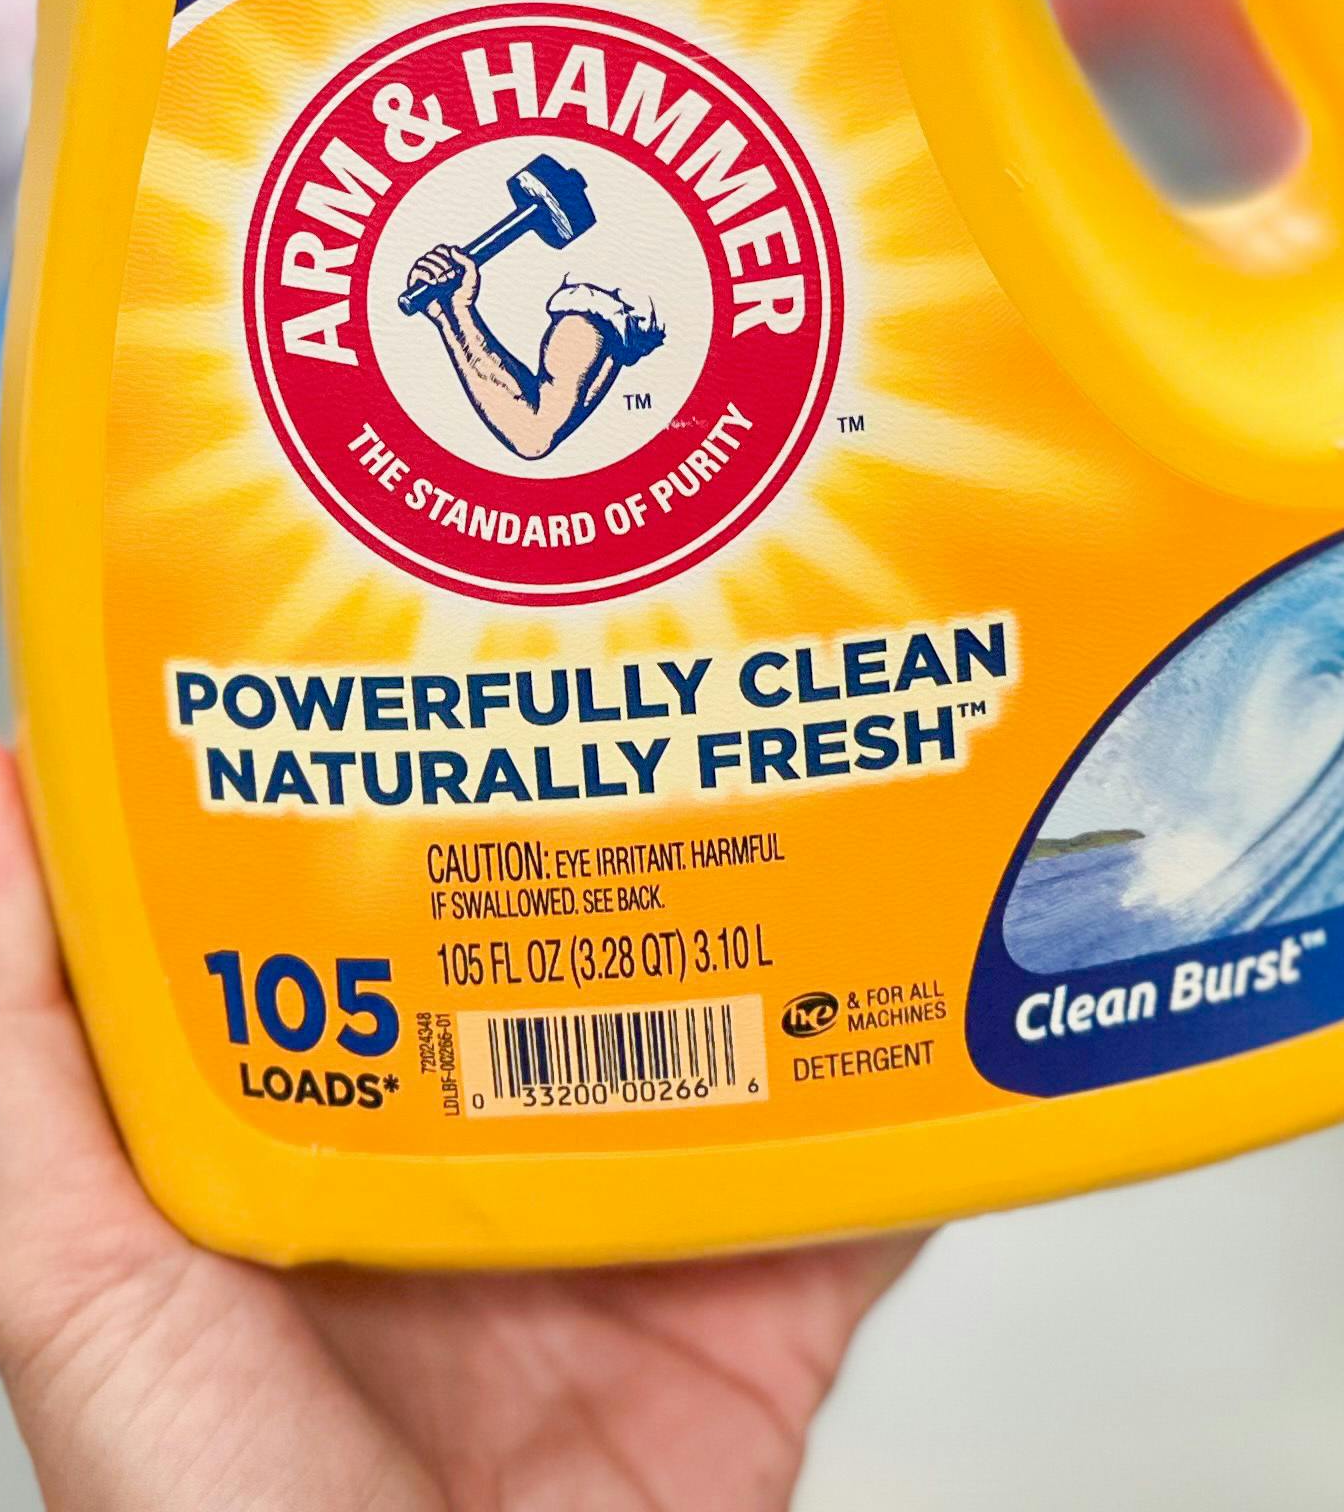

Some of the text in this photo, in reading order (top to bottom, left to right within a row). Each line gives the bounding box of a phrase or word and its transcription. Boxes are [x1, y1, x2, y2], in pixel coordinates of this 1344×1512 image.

[281, 41, 806, 368] ARM & HAMMER
[346, 401, 755, 549] THE STANDARD OF PURITY
[175, 621, 1009, 733] POWERFULLY CLEAN
[205, 737, 670, 807] NATURALLY
[427, 832, 786, 885] CAUTION: EYE IRRITANT. HARMFUL
[431, 884, 666, 921] IF SWALLOWED. SEE BACK.
[437, 923, 774, 989] 105 FL OZ (3.28 QT) 3.10 L
[204, 949, 400, 1058] 105
[847, 979, 945, 1010] & FOR ALL
[848, 1001, 947, 1032] MACHINES
[1015, 980, 1156, 1042] Clean
[793, 1040, 935, 1082] DETERGENT
[472, 1076, 759, 1109] 0 33200 00266 6
